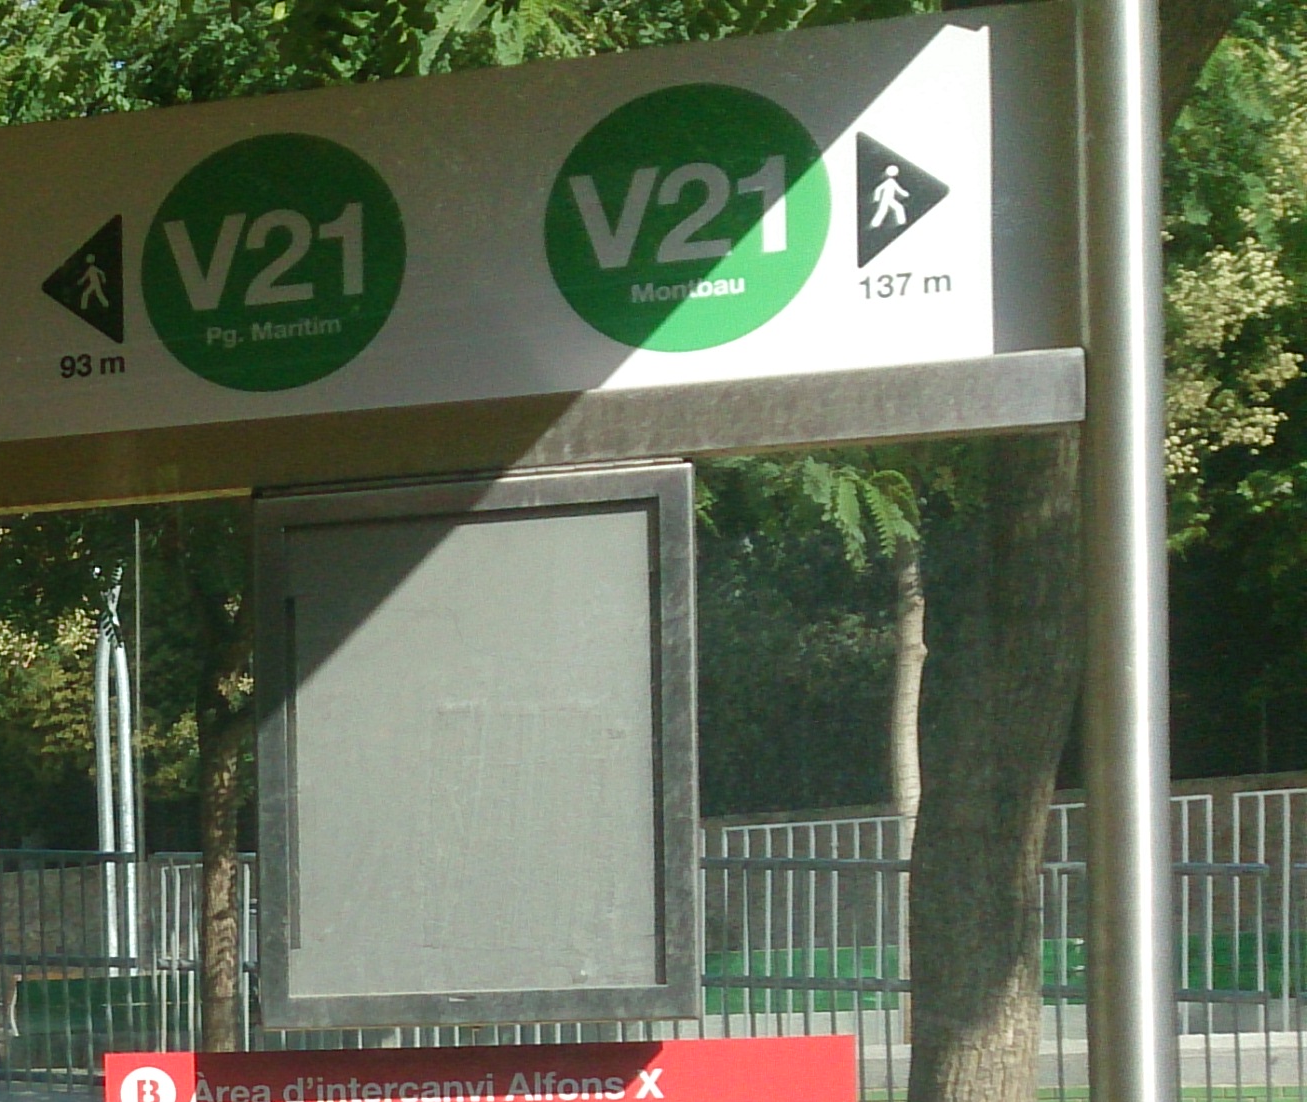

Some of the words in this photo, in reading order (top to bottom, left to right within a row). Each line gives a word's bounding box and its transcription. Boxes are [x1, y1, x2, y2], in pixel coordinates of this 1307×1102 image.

[568, 155, 789, 270] V21
[164, 202, 365, 312] V21
[631, 277, 746, 303] Montbau
[859, 272, 912, 300] 137
[923, 274, 952, 294] m
[206, 326, 244, 349] Pg.
[60, 353, 92, 378] 93
[100, 356, 125, 375] m
[507, 1069, 626, 1102] Alfons
[636, 1069, 665, 1100] X
